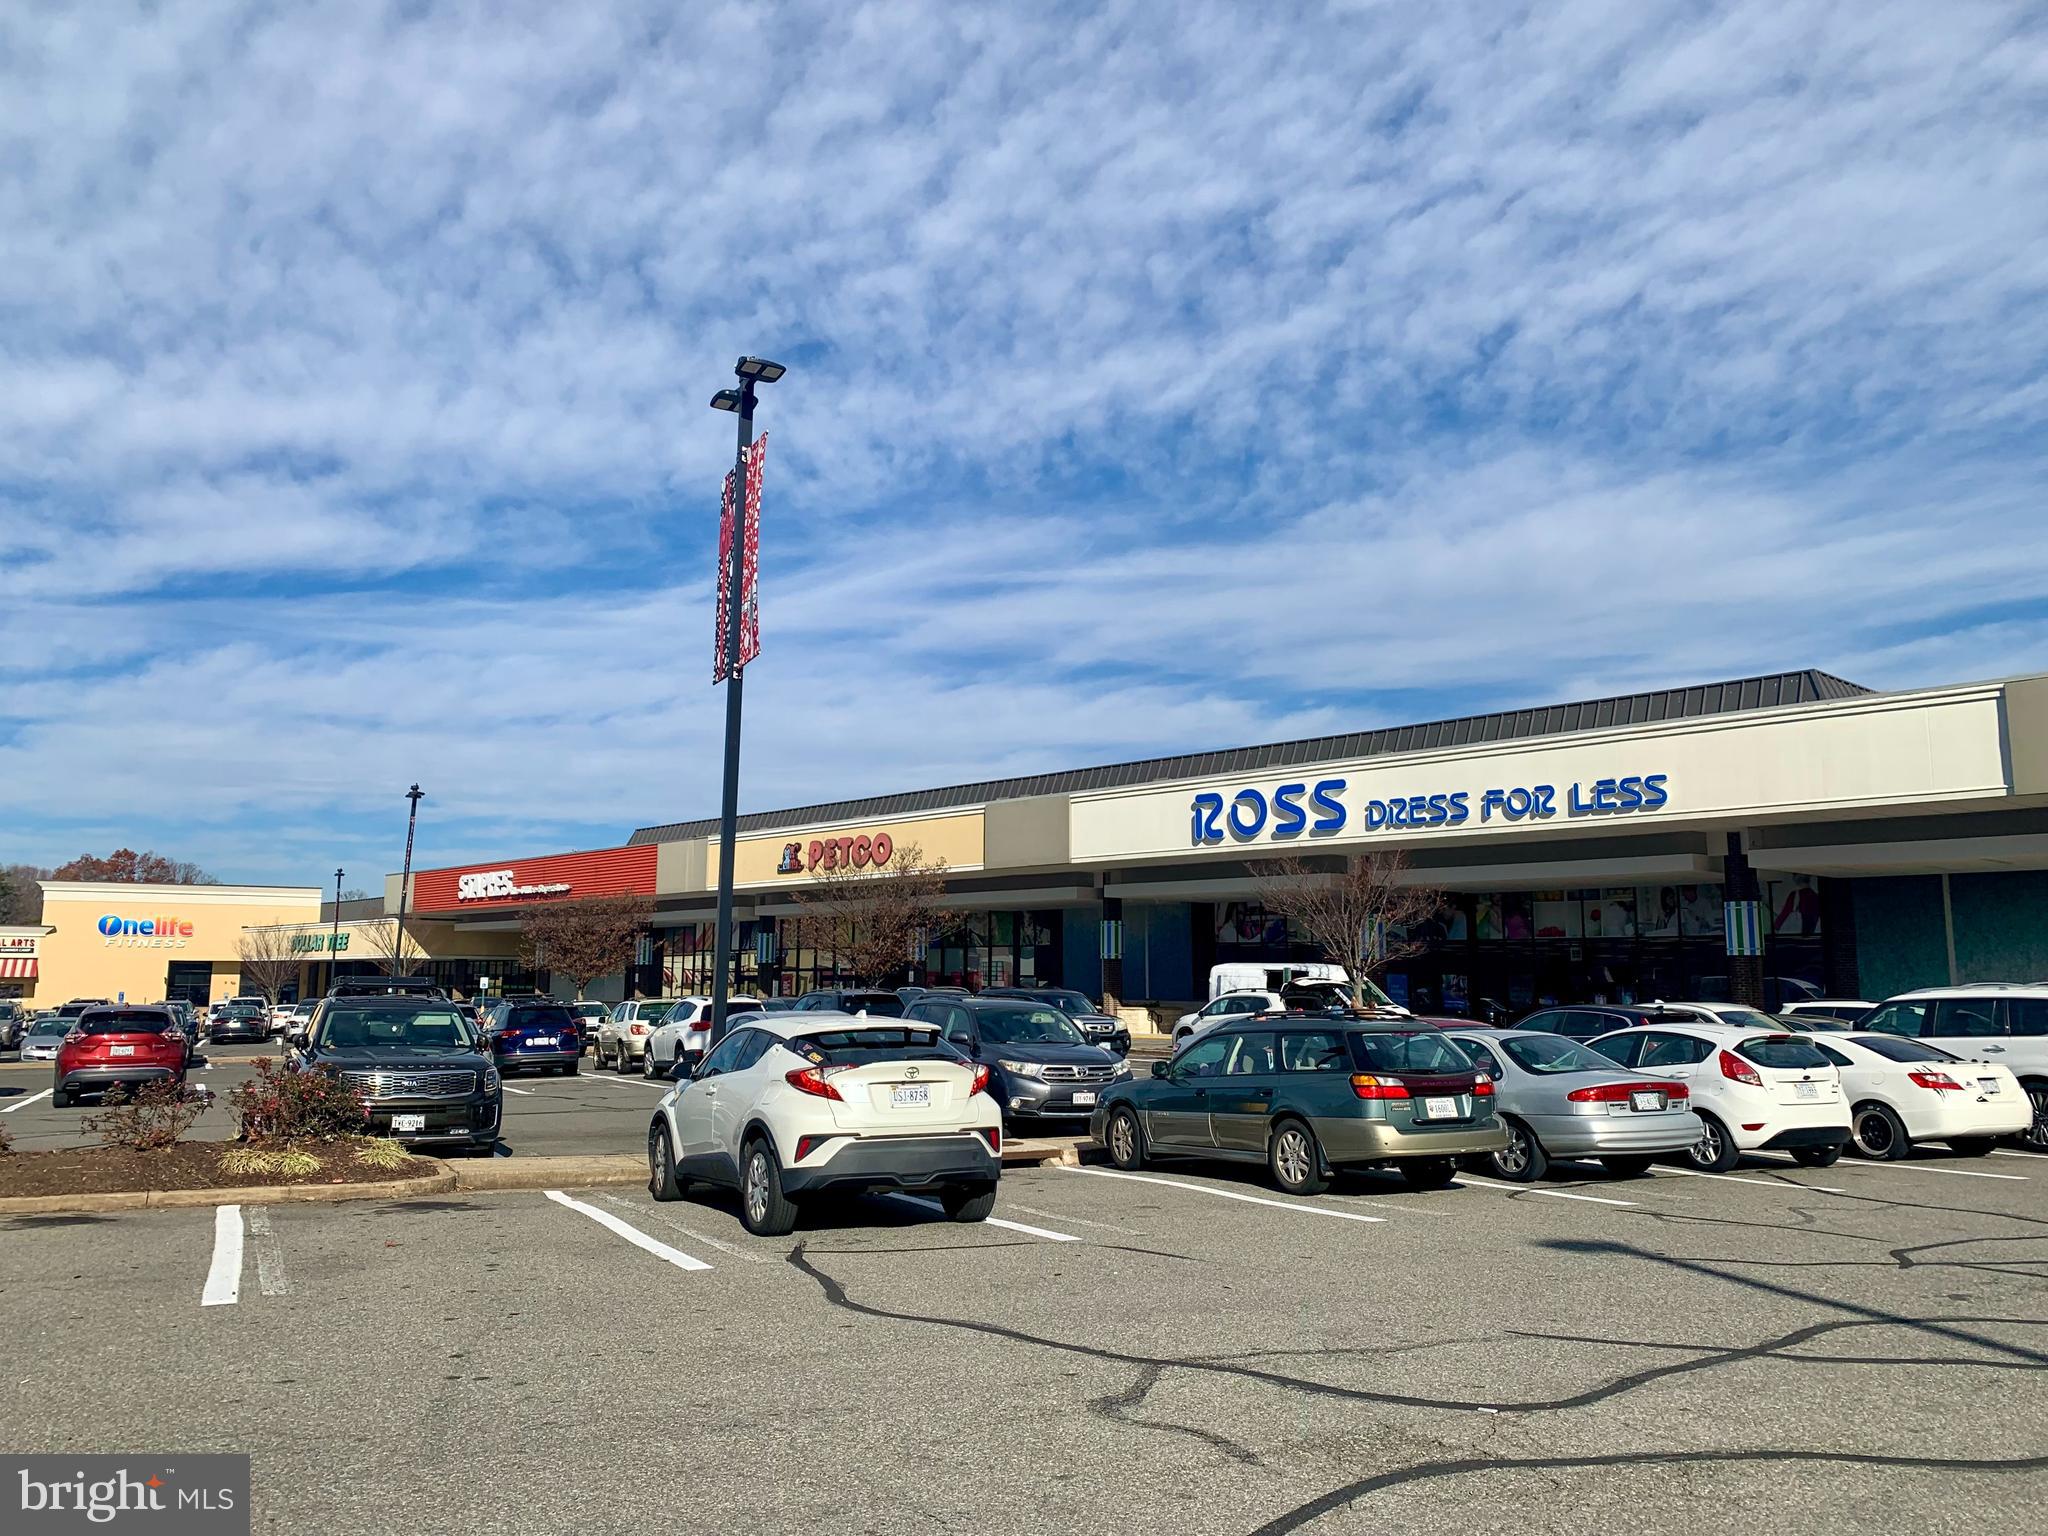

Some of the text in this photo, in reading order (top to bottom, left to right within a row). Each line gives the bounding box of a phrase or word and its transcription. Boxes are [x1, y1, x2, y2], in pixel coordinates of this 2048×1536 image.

[1193, 774, 1668, 842] ROSS DRESS FOR LESS
[808, 833, 893, 872] PETCO
[458, 870, 514, 900] STAPLES
[97, 914, 194, 937] Onelife
[0, 938, 36, 947] L ARTS
[104, 938, 187, 949] FITNESS
[290, 932, 351, 953] DOLLAR TEE
